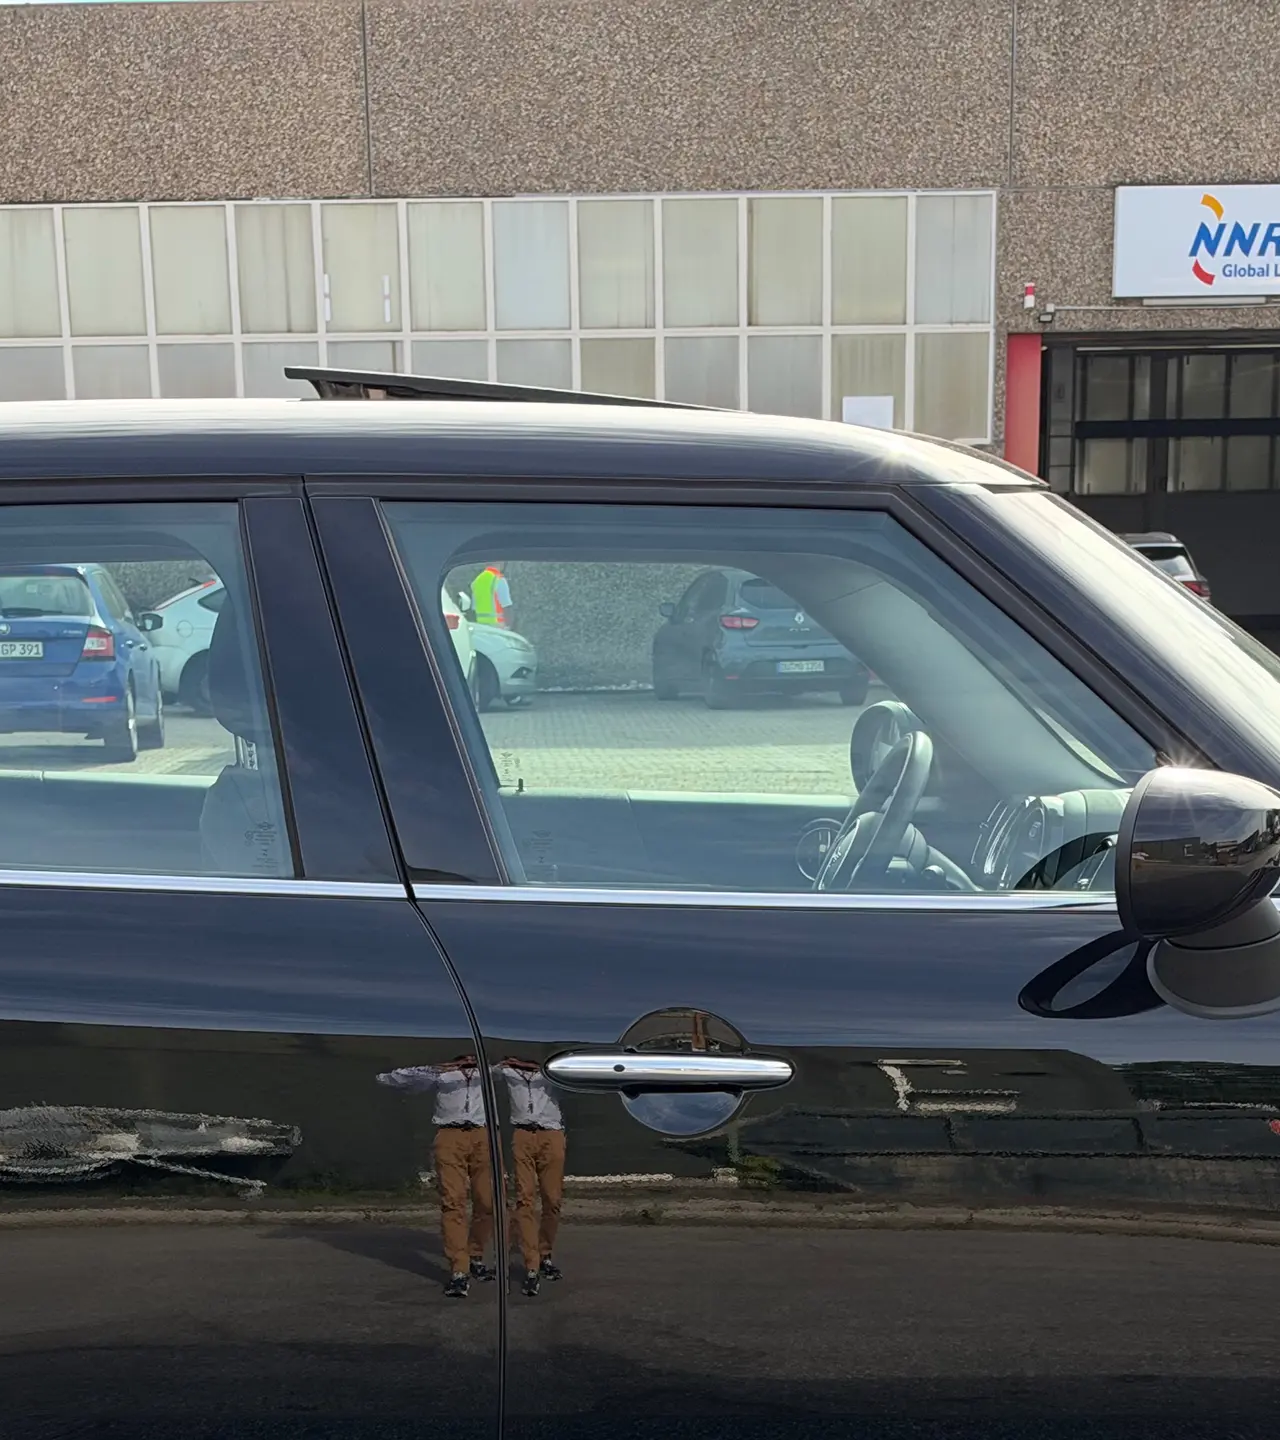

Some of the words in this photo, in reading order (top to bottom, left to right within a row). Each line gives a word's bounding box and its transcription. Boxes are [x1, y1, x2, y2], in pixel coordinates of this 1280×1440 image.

[1222, 263, 1270, 277] Global
[1, 644, 17, 656] GP
[19, 643, 42, 656] 391
